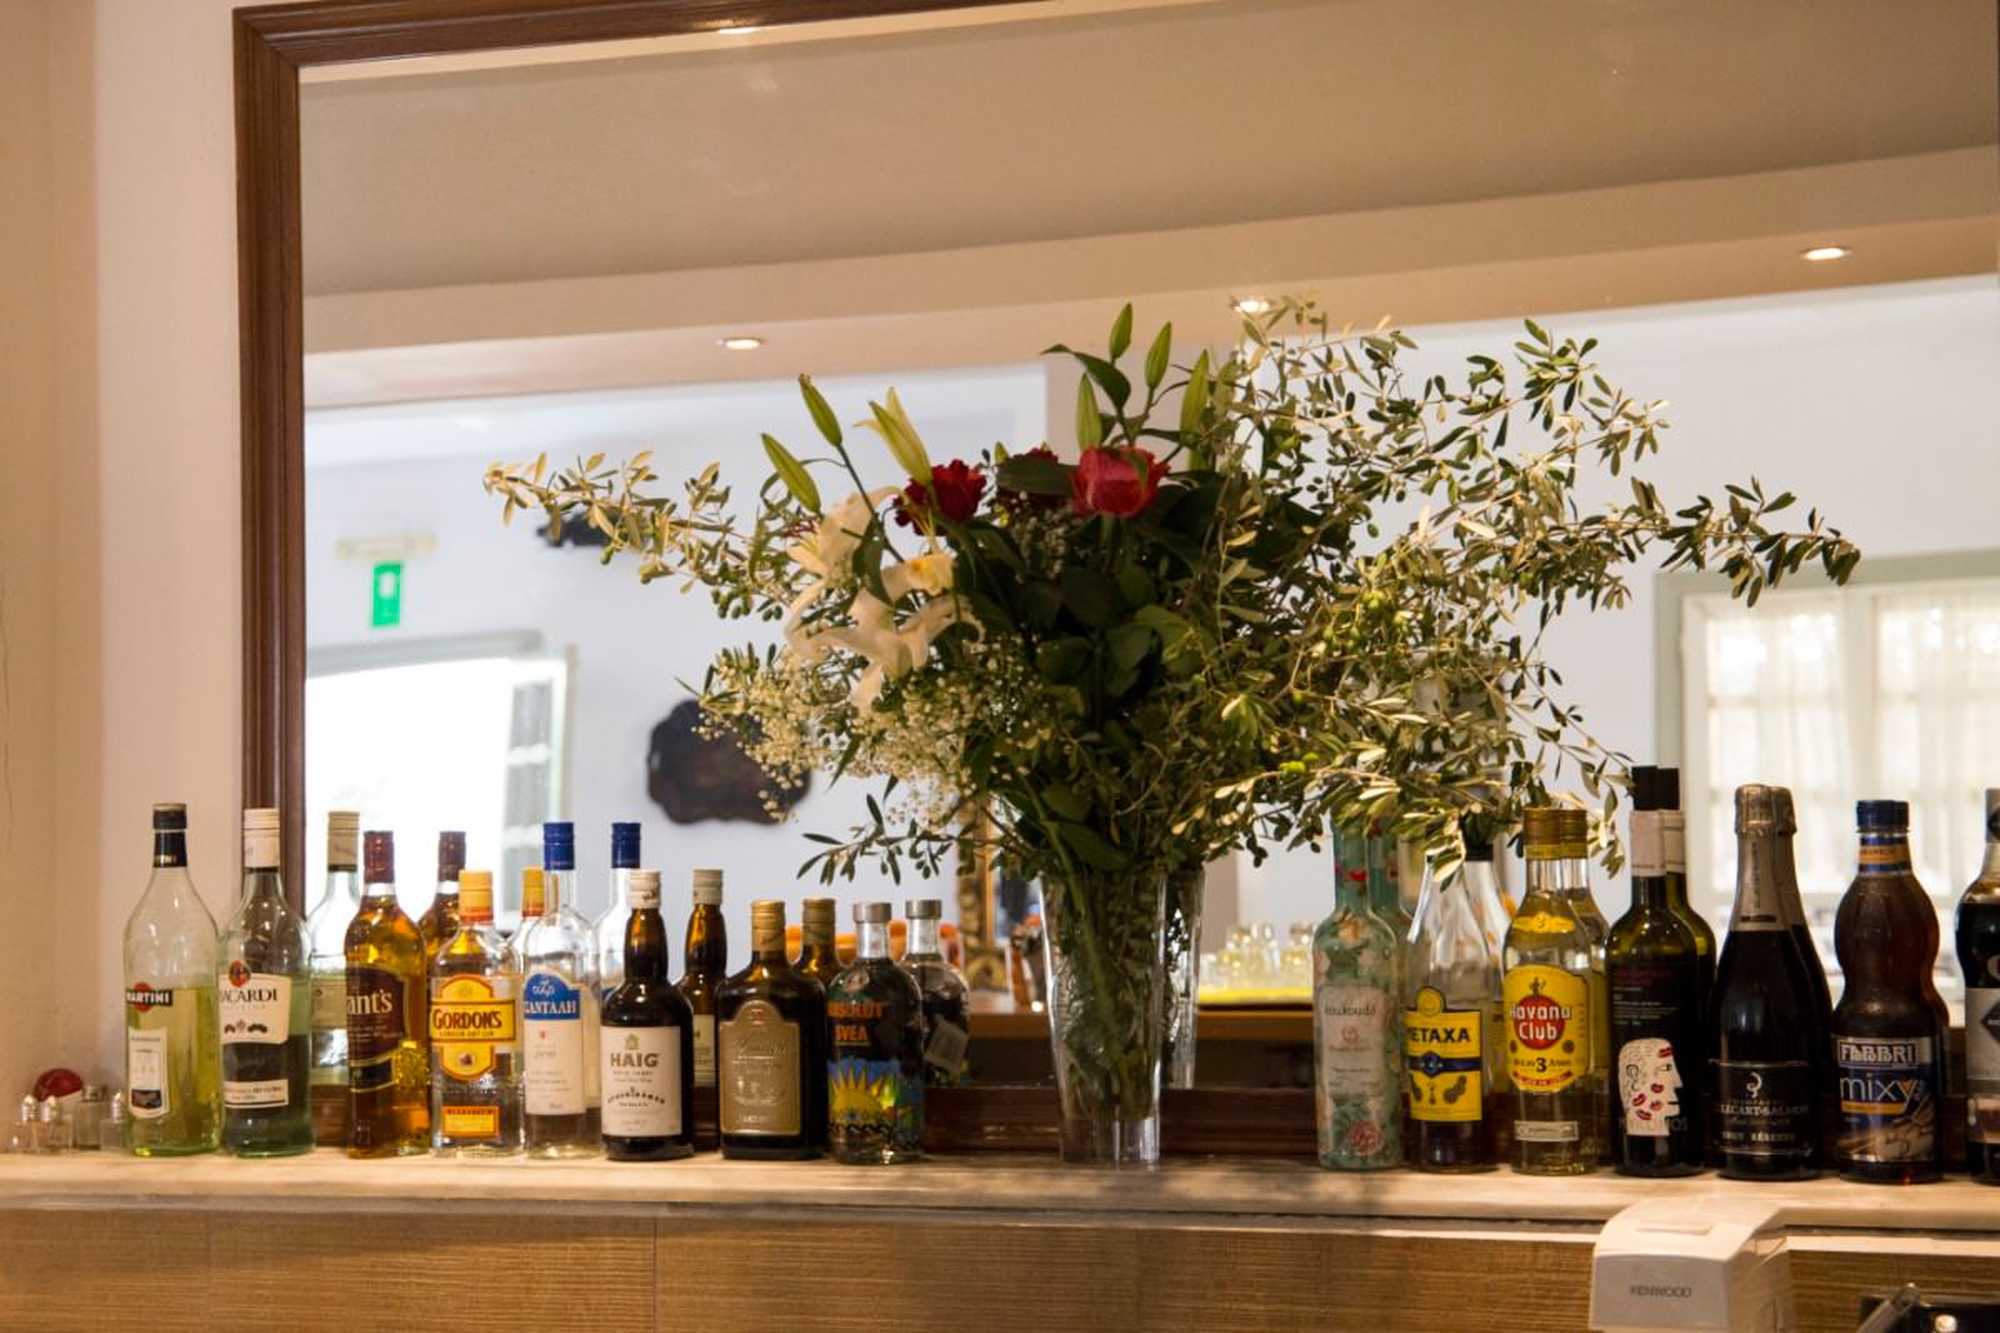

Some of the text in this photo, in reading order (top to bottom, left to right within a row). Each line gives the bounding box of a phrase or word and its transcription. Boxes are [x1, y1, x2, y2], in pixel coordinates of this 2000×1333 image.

[347, 989, 393, 1014] ant's
[1409, 1027, 1471, 1042] ETAXA
[1519, 1022, 1557, 1040] Club
[610, 1052, 659, 1068] HAIG
[1841, 1044, 1914, 1063] FABBRI
[1536, 1057, 1548, 1073] 3
[1840, 1072, 1918, 1112] mixy
